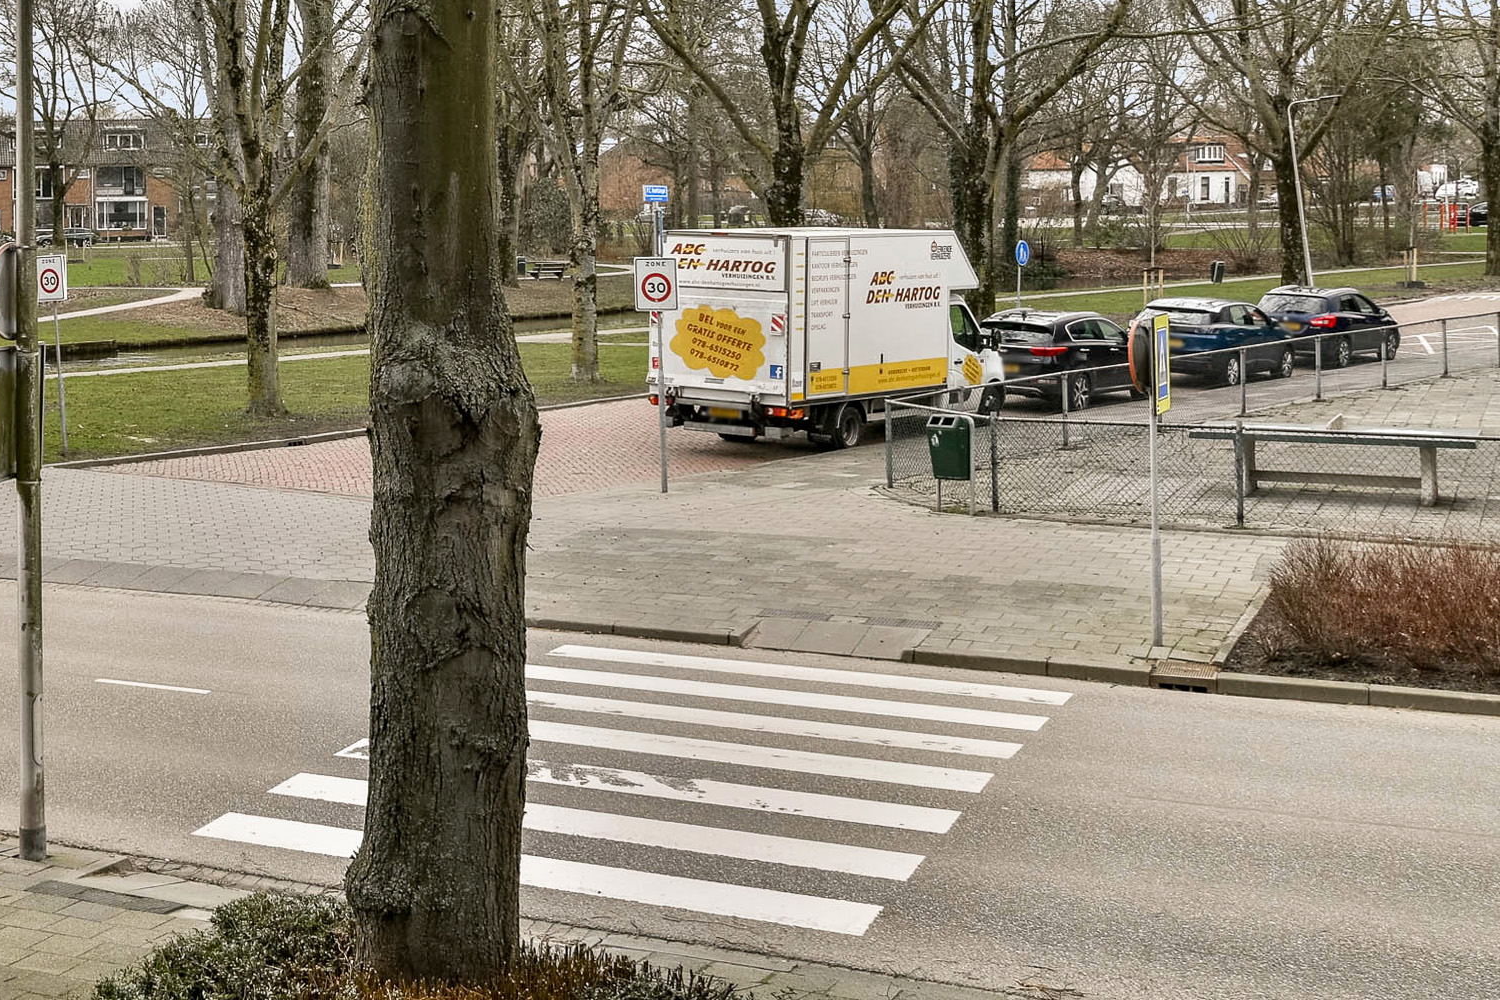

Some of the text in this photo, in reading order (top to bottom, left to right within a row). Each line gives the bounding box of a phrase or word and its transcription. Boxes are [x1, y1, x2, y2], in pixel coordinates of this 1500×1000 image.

[670, 243, 706, 255] ABC
[677, 258, 776, 273] EN HARTOG
[44, 276, 56, 286] 30
[870, 270, 895, 286] ABC
[647, 282, 666, 293] 30
[866, 286, 941, 304] DEN HARTOG
[698, 313, 747, 335] BEL VOOR EEN
[687, 323, 754, 351] GRATIS OFFERTE
[691, 337, 742, 360] 078-6515250
[689, 348, 740, 371] 078-6510872
